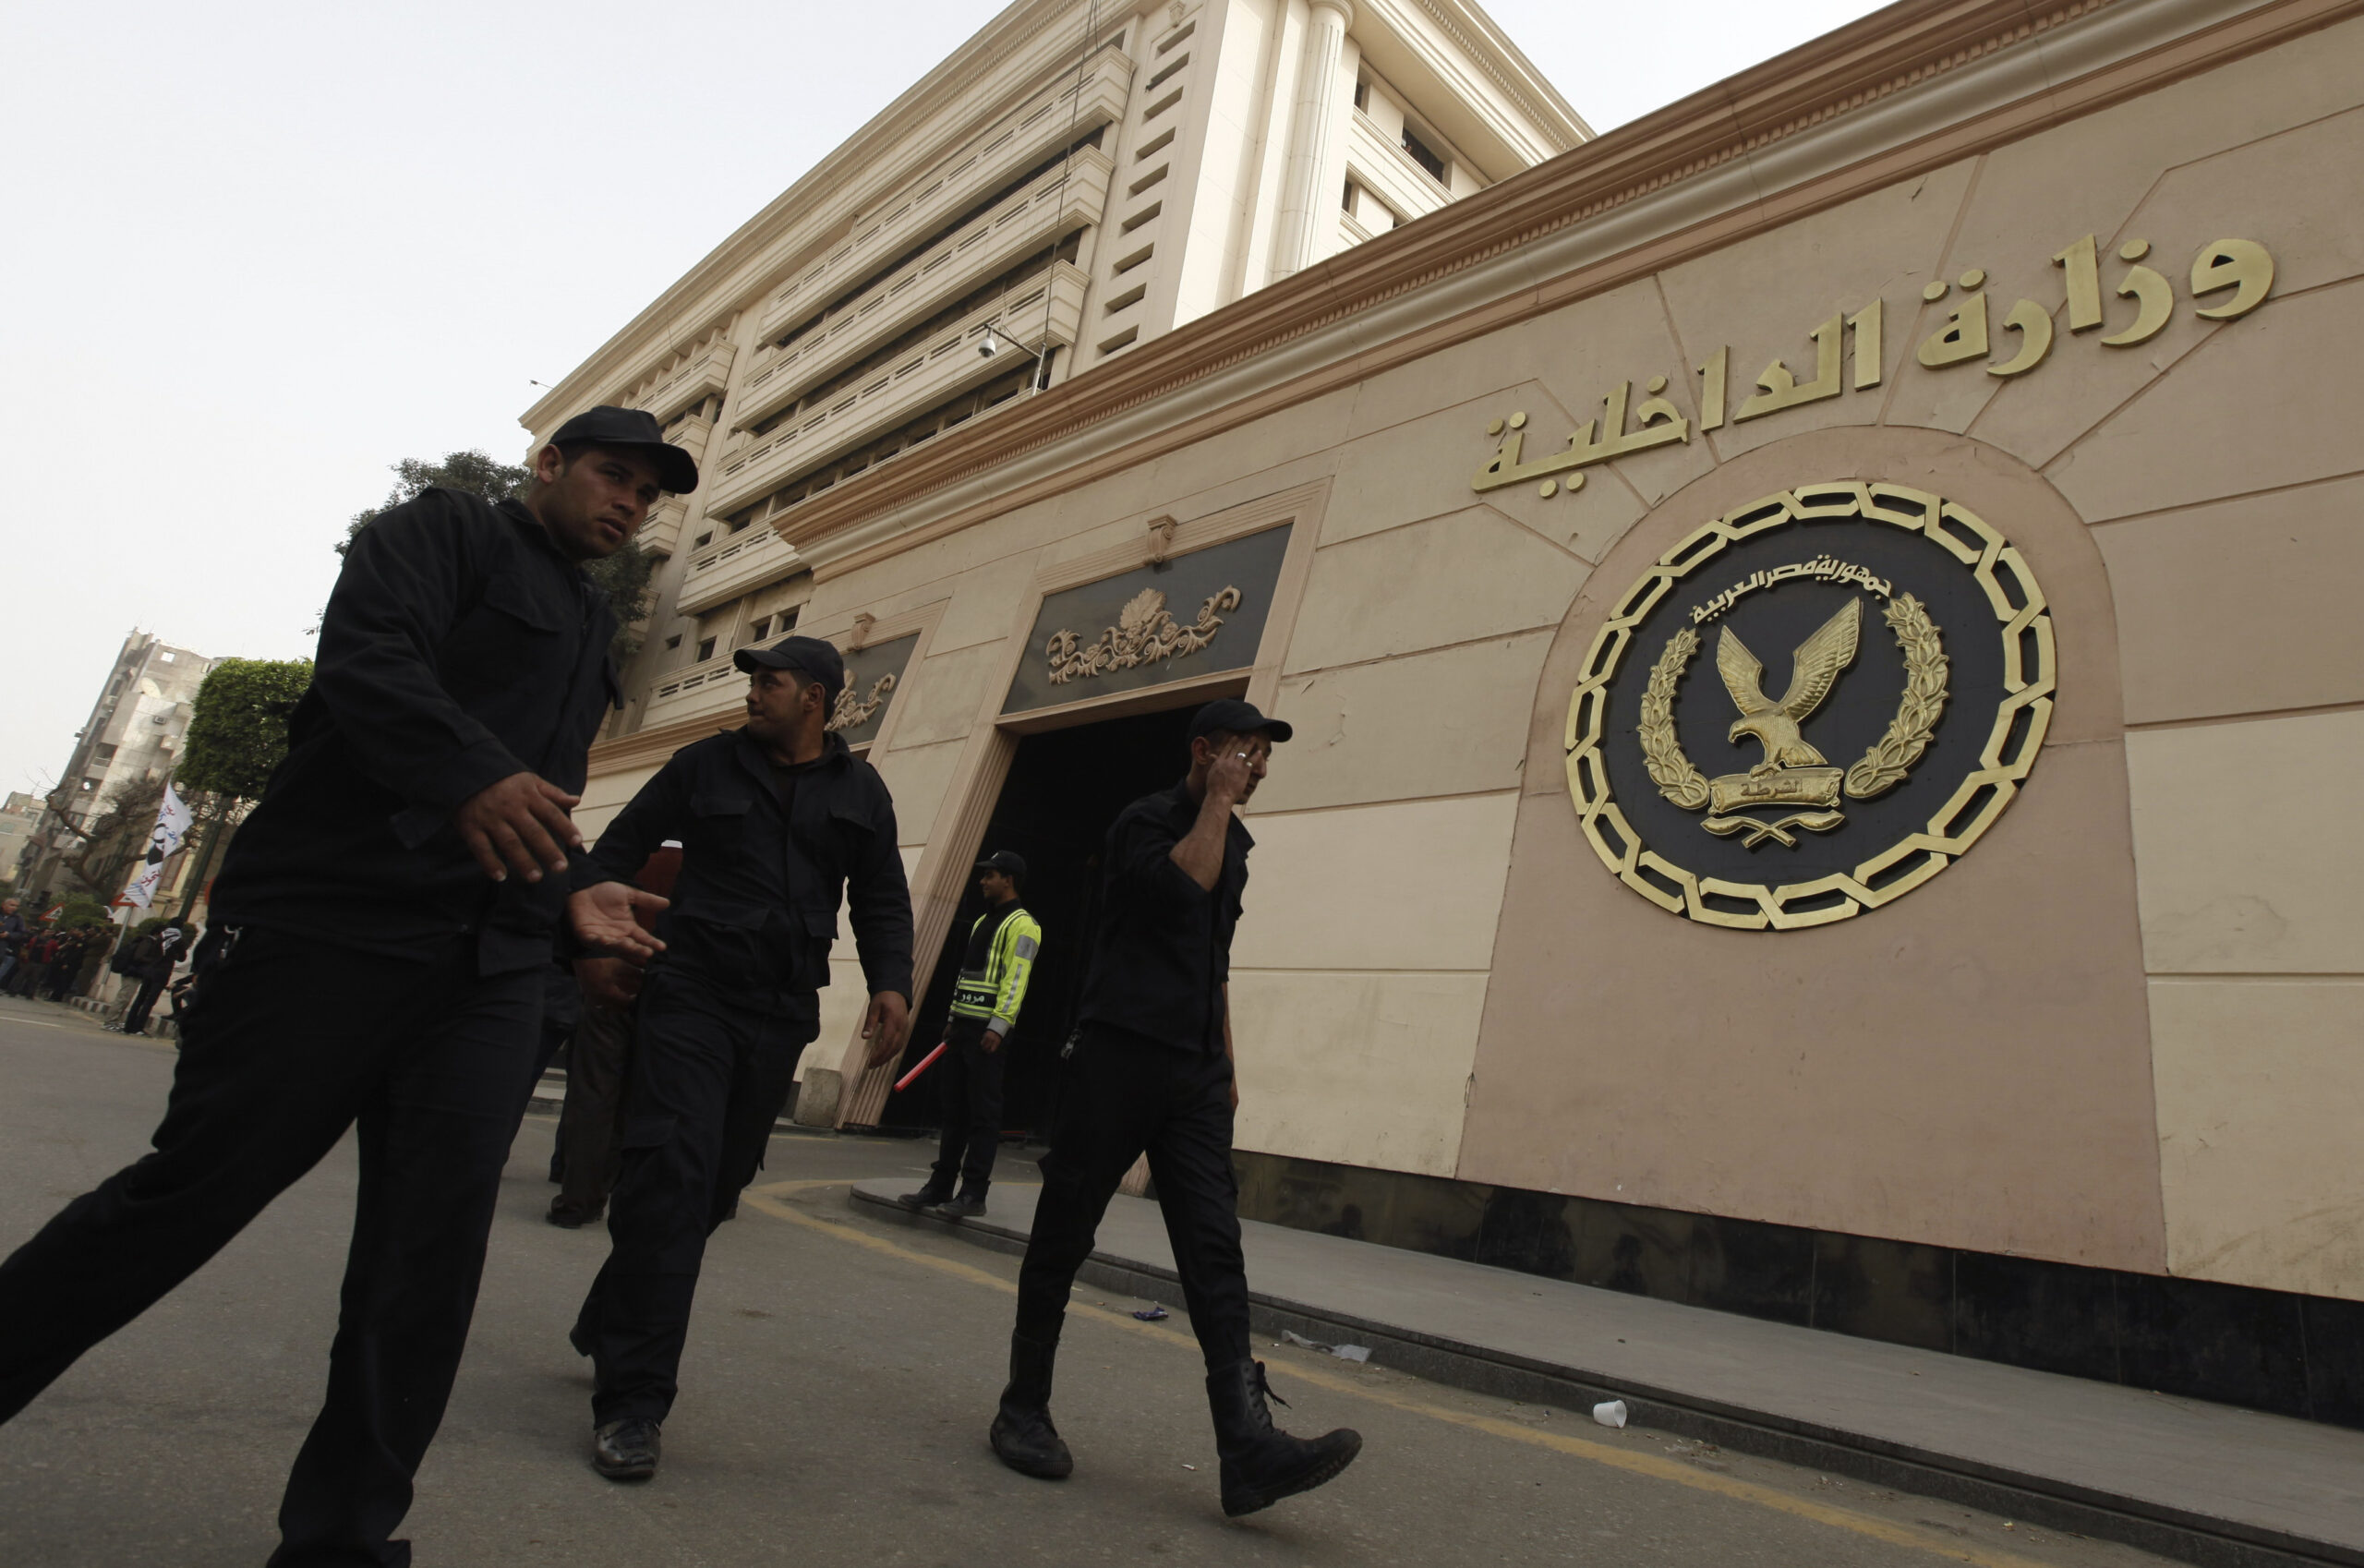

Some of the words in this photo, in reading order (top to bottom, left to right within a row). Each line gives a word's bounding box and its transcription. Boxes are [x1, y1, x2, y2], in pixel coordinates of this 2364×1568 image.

[1917, 233, 2274, 378] وزارة
[1470, 296, 1882, 500] الداخلية
[1689, 570, 1766, 624] العربية
[1765, 560, 1817, 588] مصر
[1814, 554, 1892, 600] جمهورية
[1740, 777, 1803, 799] الشرطة
[960, 994, 985, 1005] مرور
